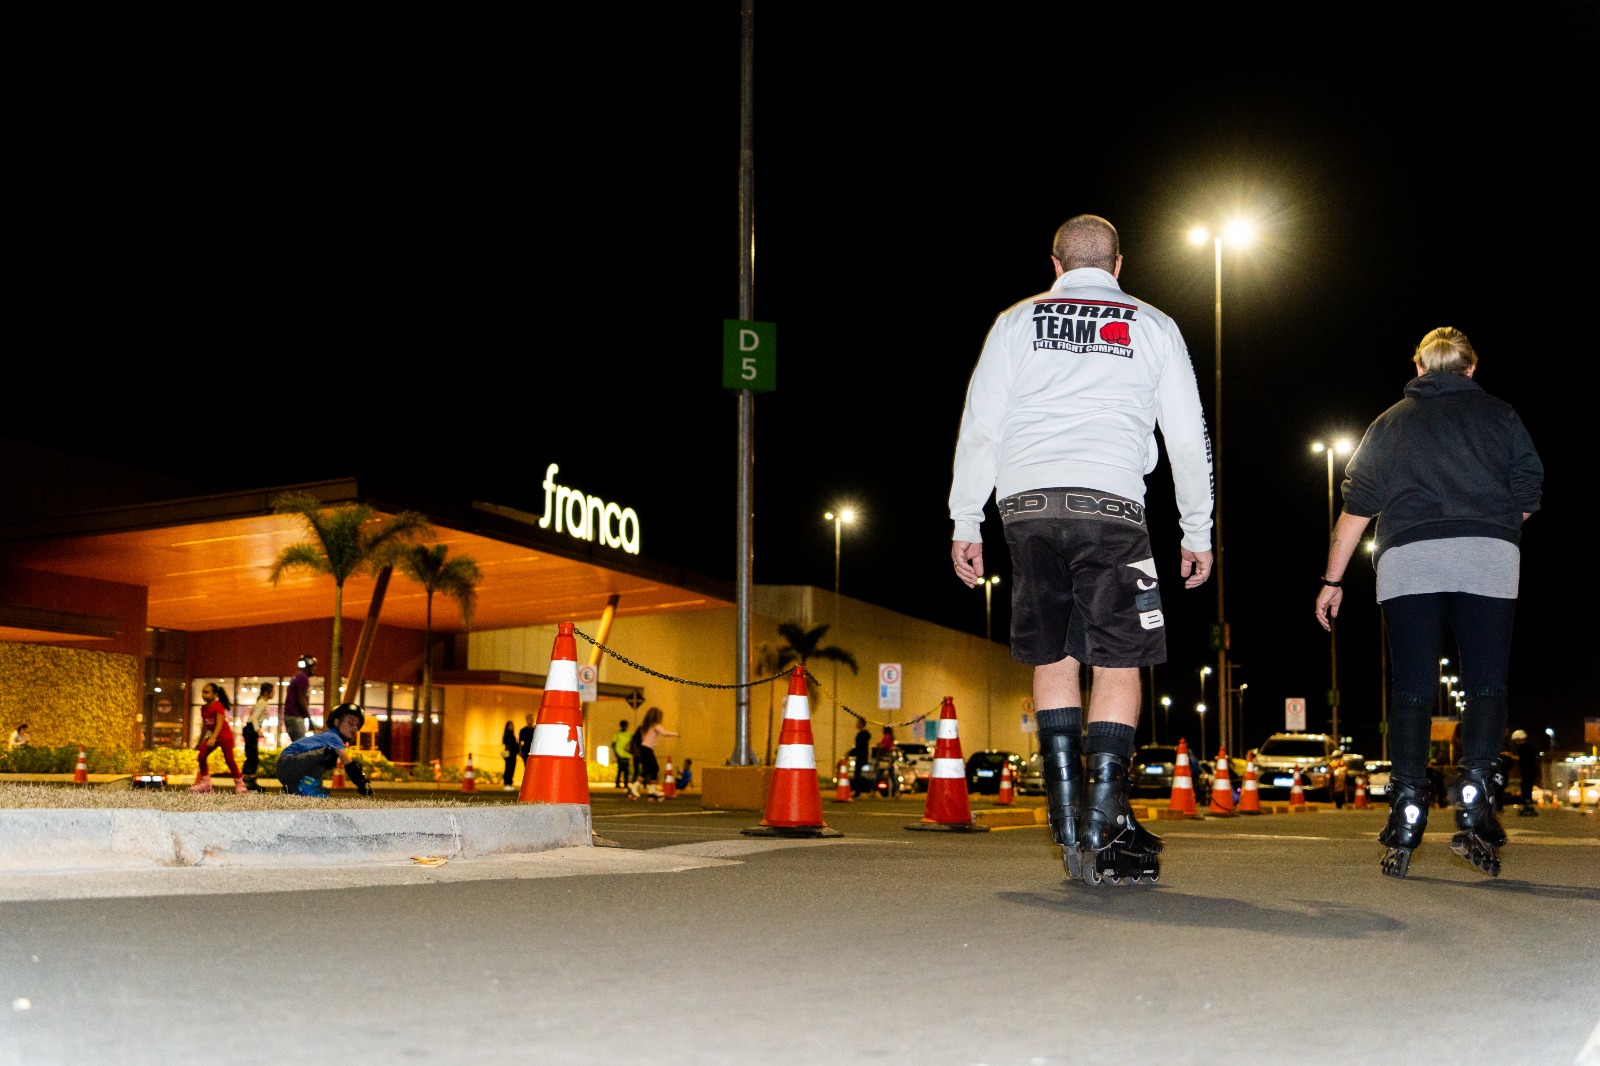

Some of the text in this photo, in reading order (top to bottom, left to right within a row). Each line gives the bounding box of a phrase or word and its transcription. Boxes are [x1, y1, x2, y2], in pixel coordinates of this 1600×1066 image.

[1033, 304, 1137, 321] KORAL
[740, 329, 760, 351] D
[1033, 316, 1097, 344] TEAM
[1057, 342, 1084, 353] FIGHT
[1086, 345, 1133, 358] COMPANY
[741, 358, 757, 380] 5
[539, 463, 640, 555] franca
[998, 493, 1144, 525] AD BOY
